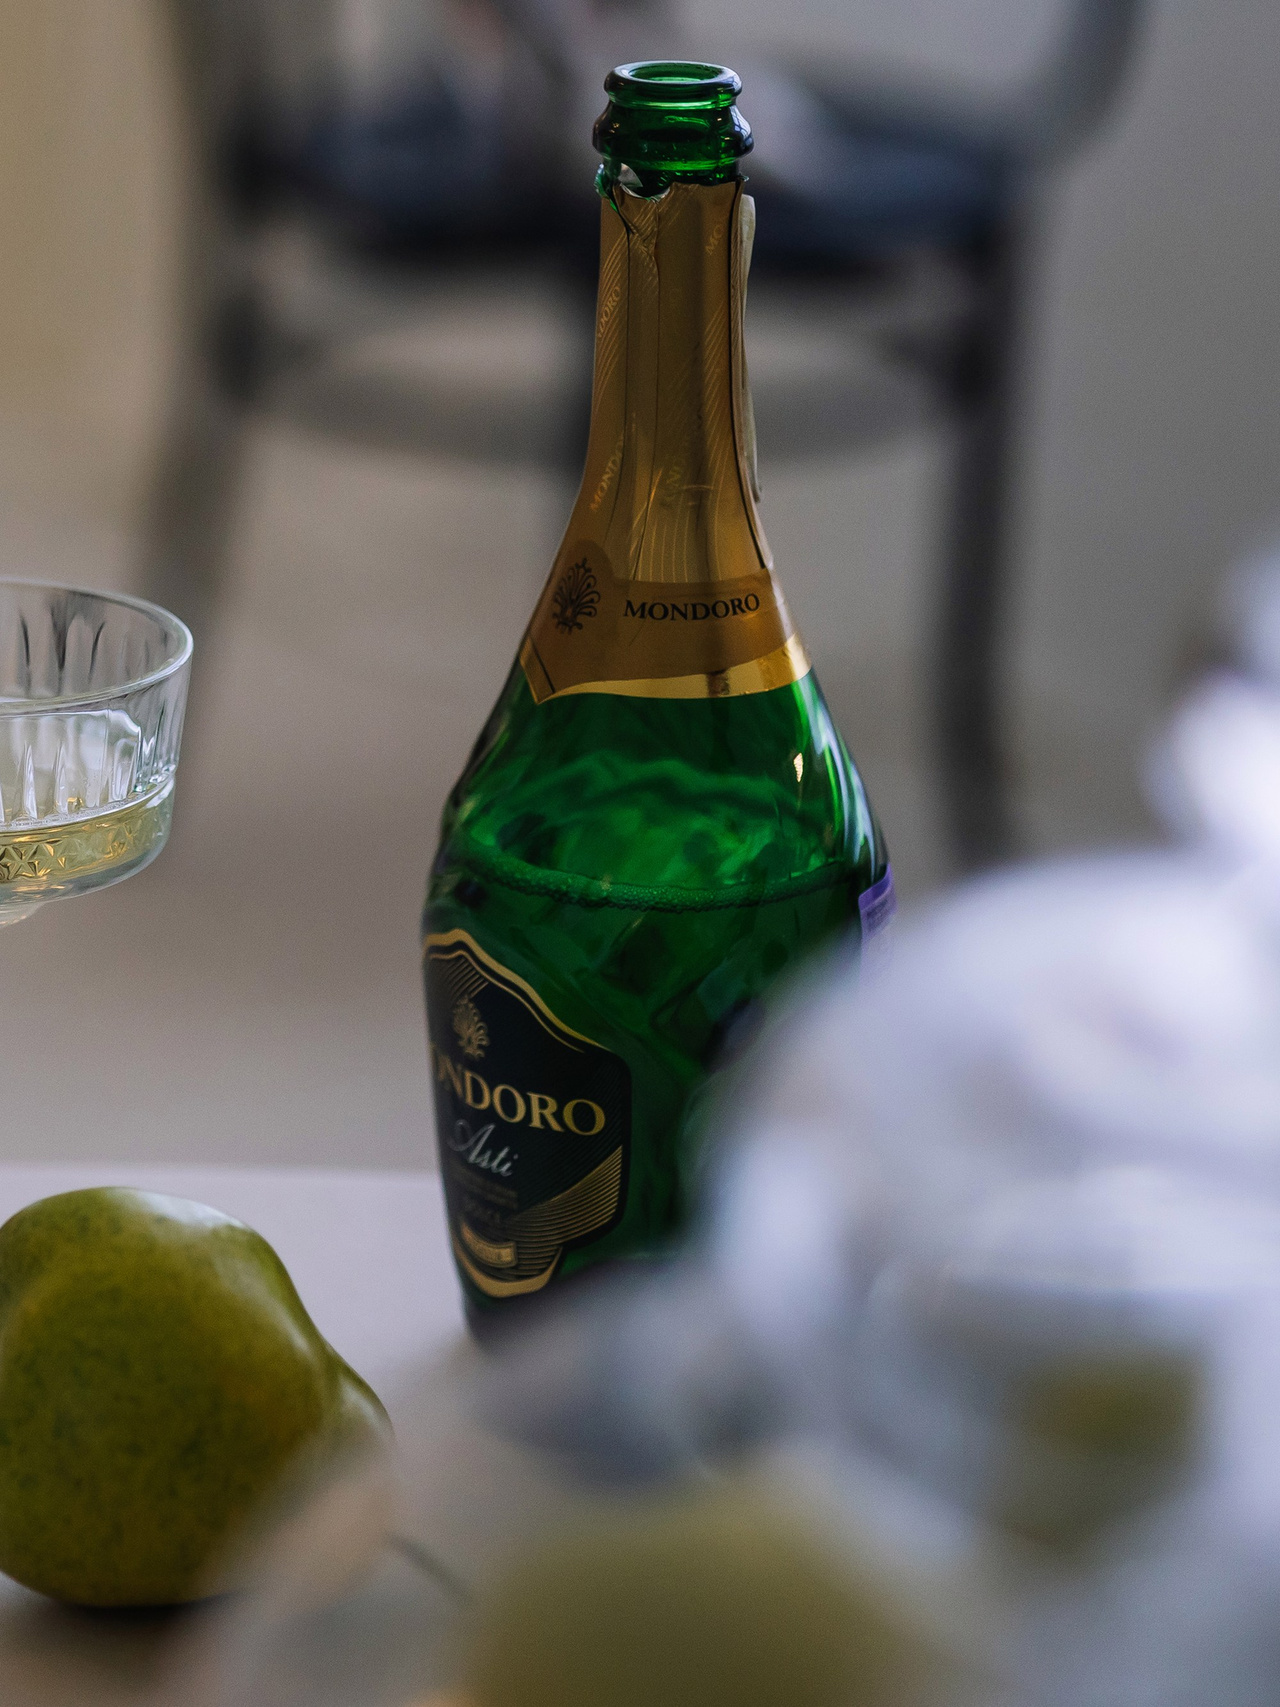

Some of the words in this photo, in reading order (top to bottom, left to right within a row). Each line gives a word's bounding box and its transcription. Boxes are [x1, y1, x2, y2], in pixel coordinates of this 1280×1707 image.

[623, 592, 761, 622] MONDORO
[432, 1042, 607, 1137] NDORO
[447, 1118, 519, 1178] Asti
